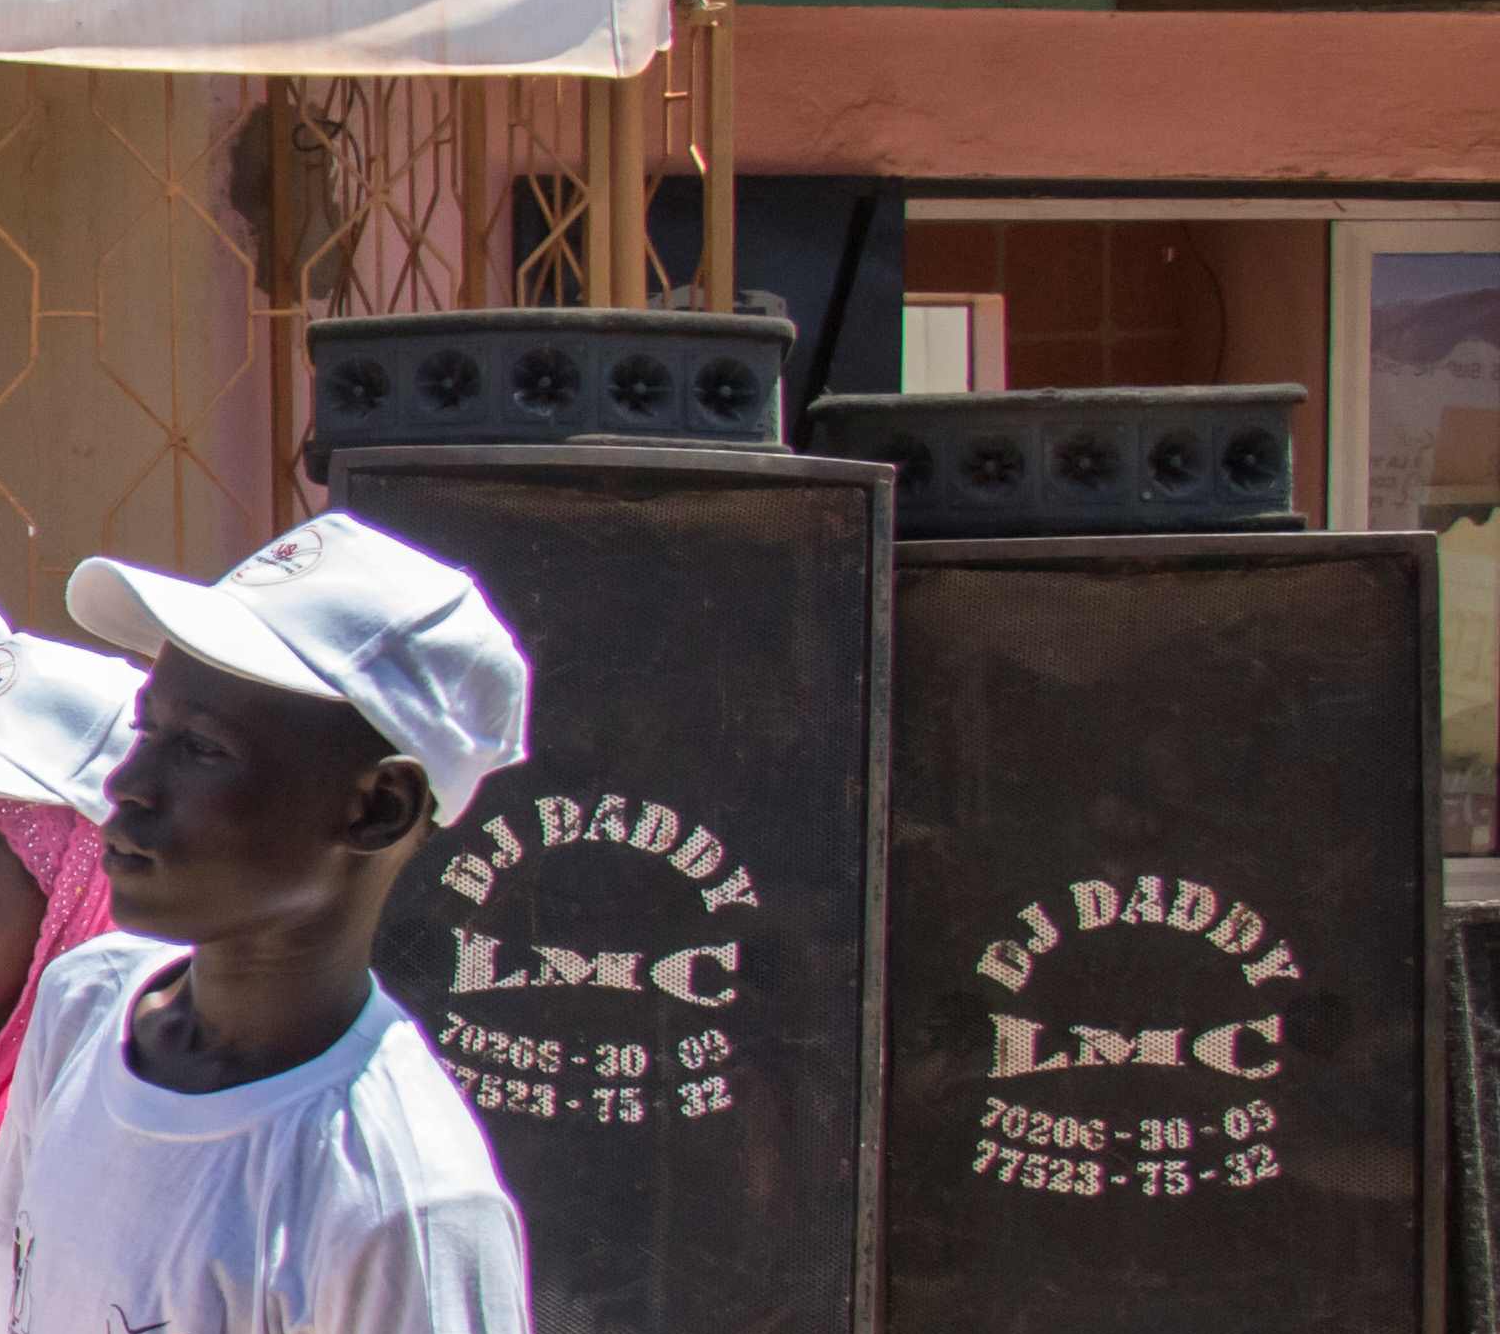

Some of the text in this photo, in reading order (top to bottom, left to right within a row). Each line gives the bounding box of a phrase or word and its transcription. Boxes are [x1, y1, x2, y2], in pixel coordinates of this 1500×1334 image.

[440, 793, 759, 913] DJ DADDY
[448, 927, 741, 1008] LMC
[976, 875, 1302, 993] DJ DADDY
[986, 1013, 1285, 1080] LMC
